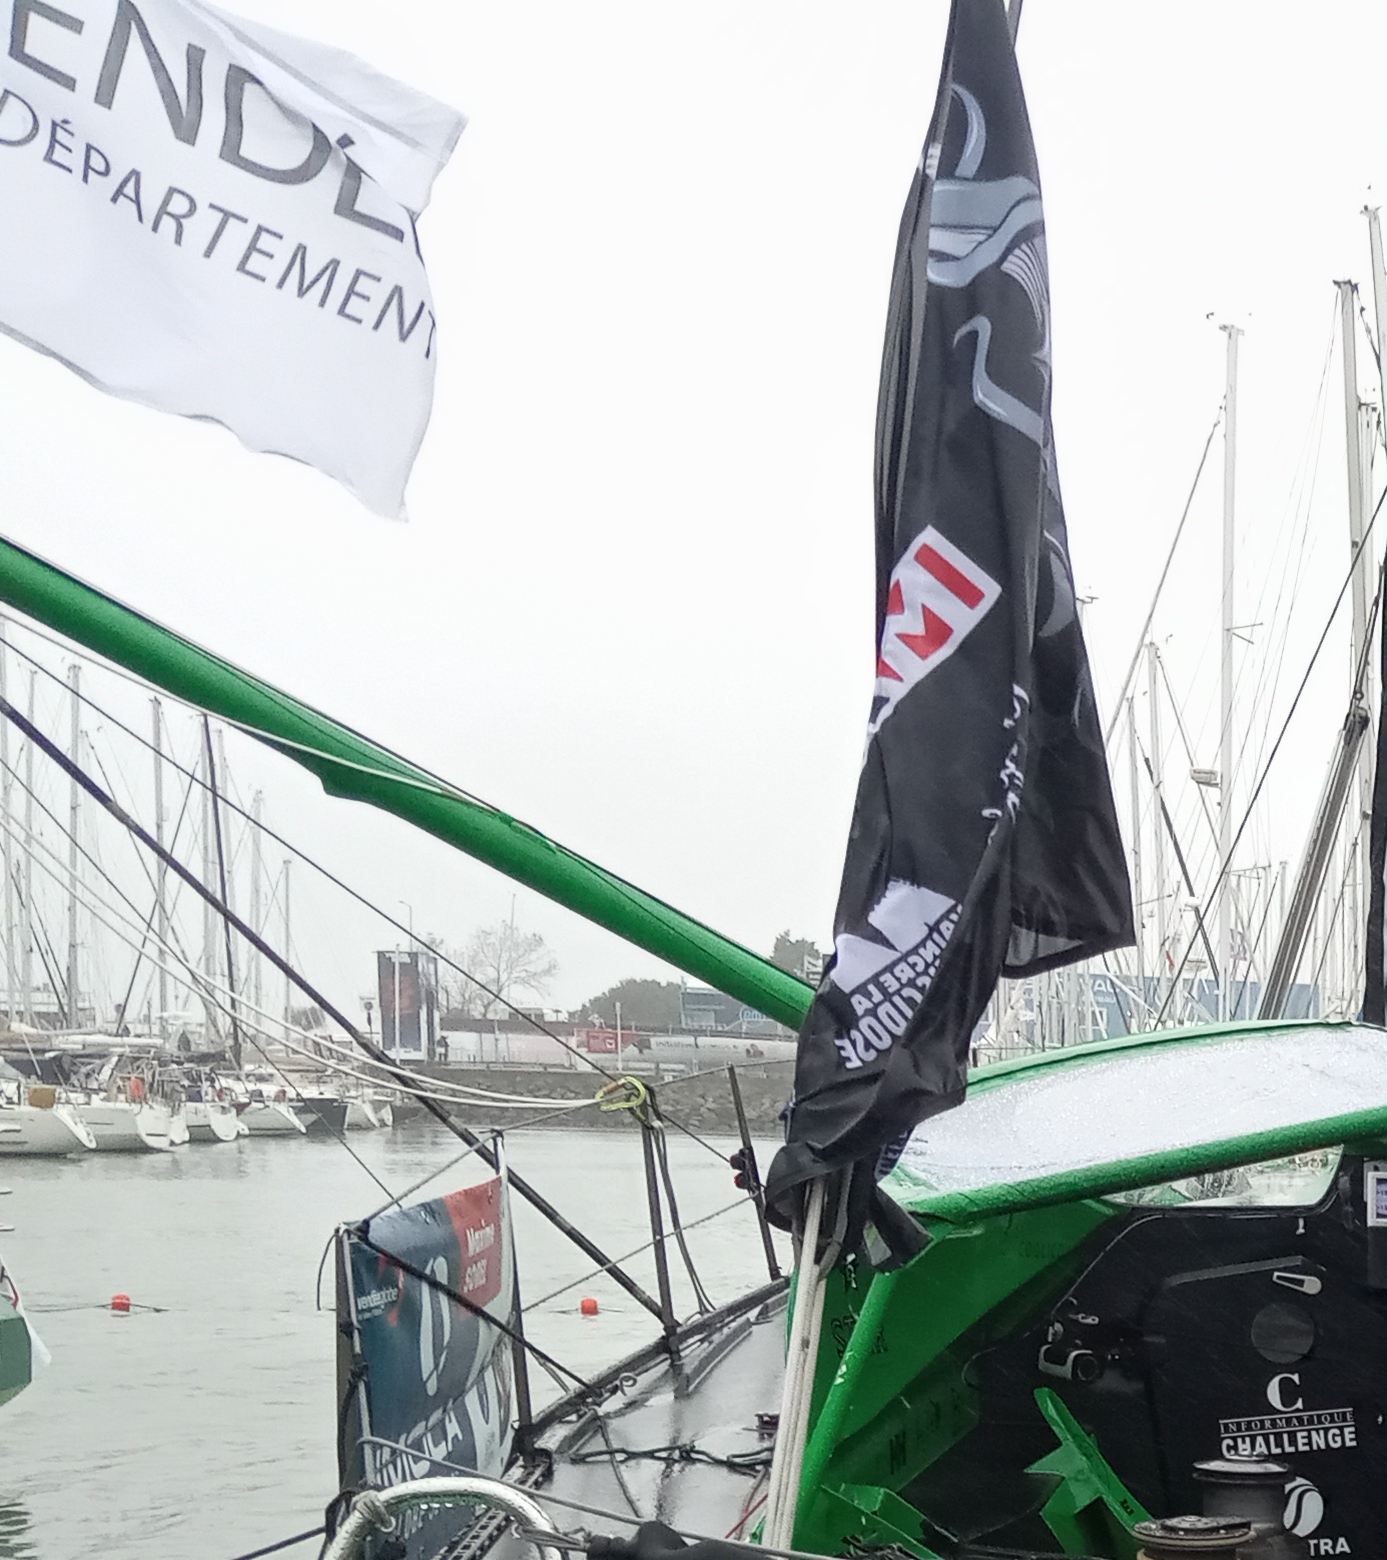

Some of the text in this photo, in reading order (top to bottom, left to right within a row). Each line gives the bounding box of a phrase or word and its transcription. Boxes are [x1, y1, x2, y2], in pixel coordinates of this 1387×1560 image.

[1266, 1372, 1304, 1412] C
[1219, 1409, 1355, 1434] INFORMATIQUE
[1220, 1426, 1358, 1458] CHALLENGE
